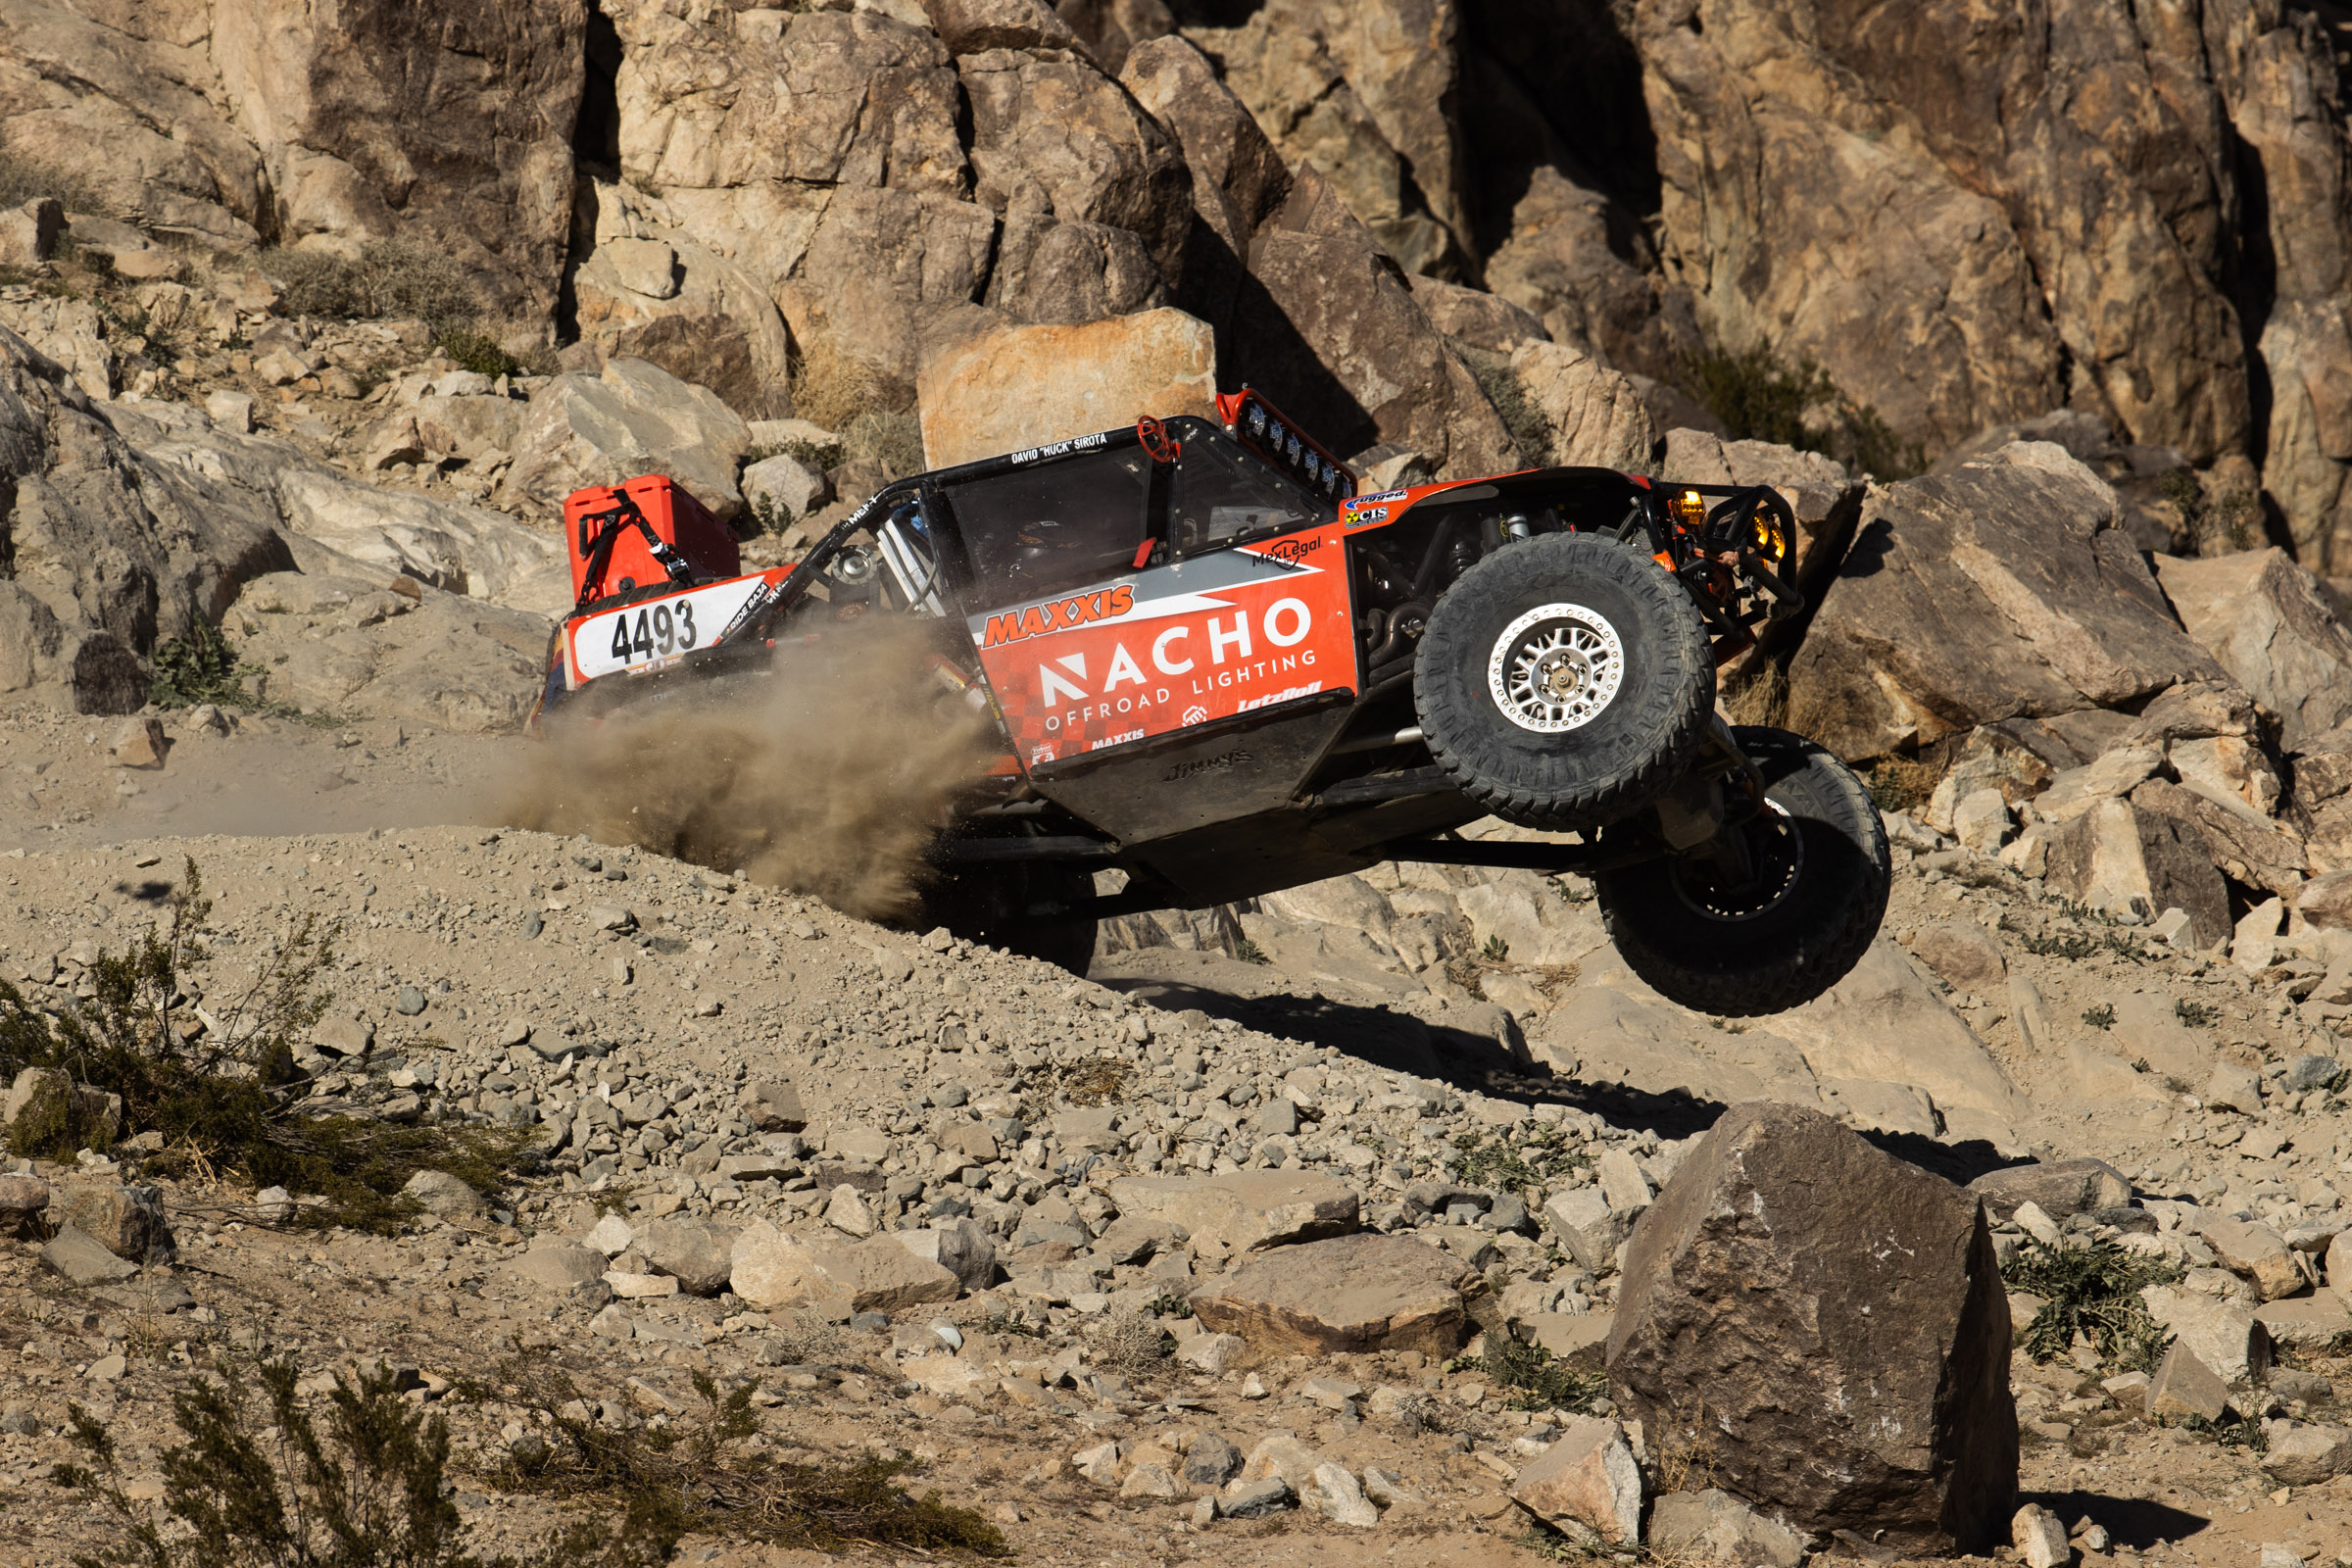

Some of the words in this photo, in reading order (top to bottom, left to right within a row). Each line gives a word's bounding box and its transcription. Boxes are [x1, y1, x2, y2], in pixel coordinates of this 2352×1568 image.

[1011, 448, 1039, 464] DAVID
[1039, 440, 1072, 457] "HUCK"
[1074, 432, 1107, 450] SIROTA
[1359, 507, 1388, 520] CIS
[1252, 535, 1321, 567] MexLegal
[730, 606, 749, 630] RIDE
[747, 583, 768, 610] BAJA
[982, 584, 1134, 649] MAXXIS
[612, 599, 697, 664] 4493
[1039, 598, 1311, 708] NACHO
[1045, 688, 1170, 730] OFFROAD
[1193, 650, 1316, 694] LIGHTING
[1092, 728, 1145, 751] MAXXIS
